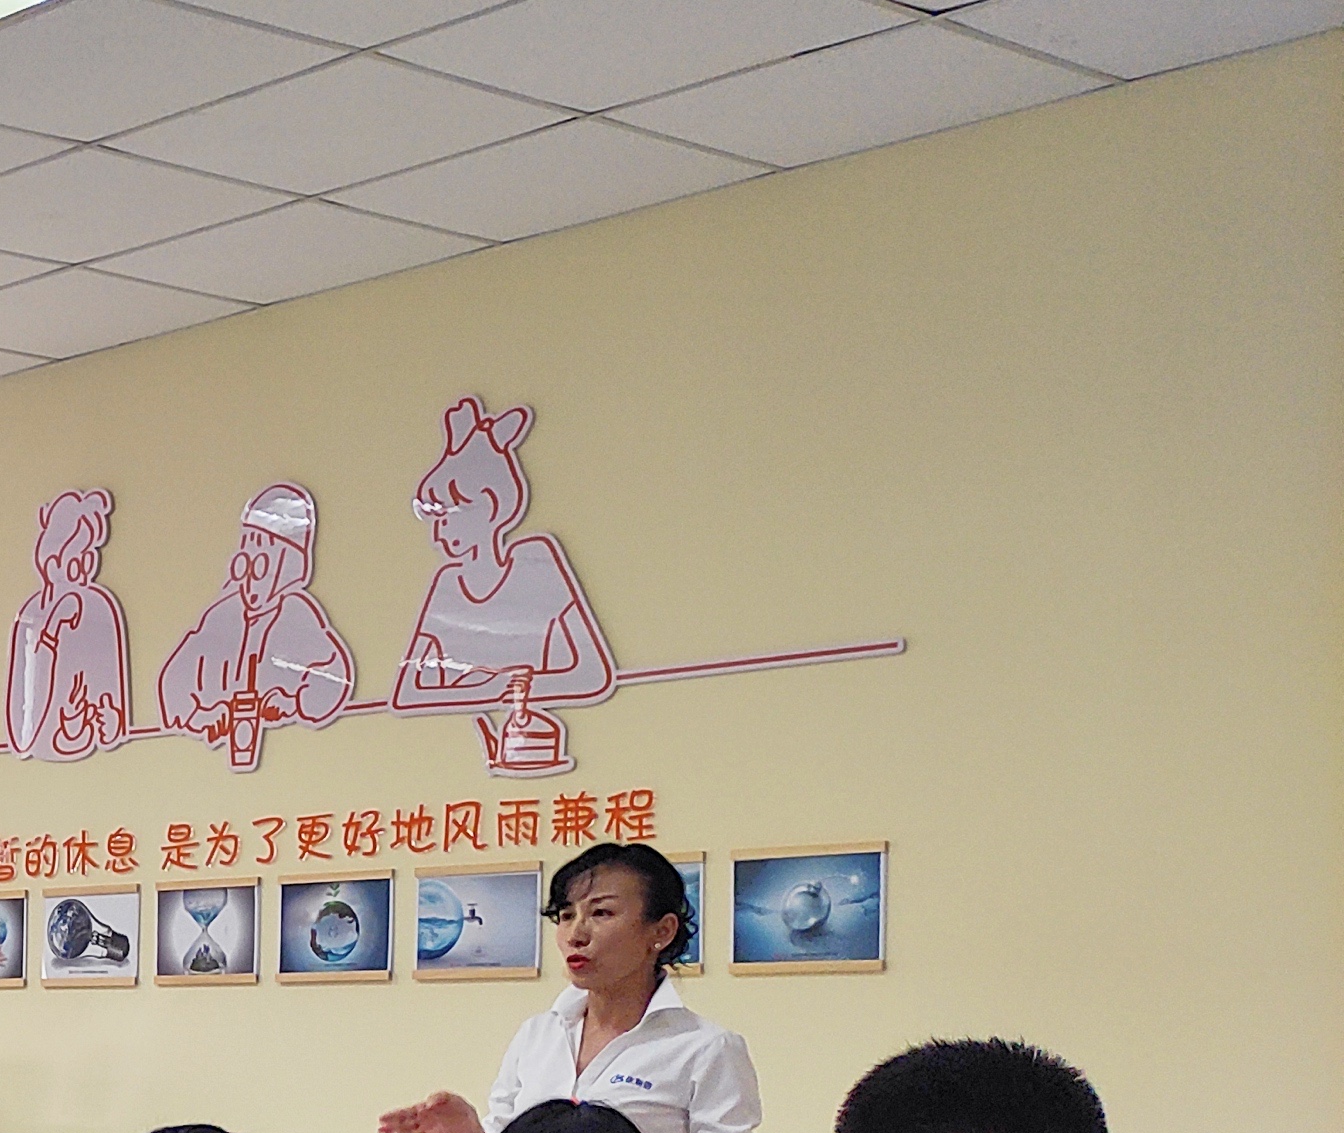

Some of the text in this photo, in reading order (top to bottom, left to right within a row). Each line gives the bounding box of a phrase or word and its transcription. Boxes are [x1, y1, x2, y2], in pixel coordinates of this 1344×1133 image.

[160, 788, 658, 871] 是为了更好地风雨兼程
